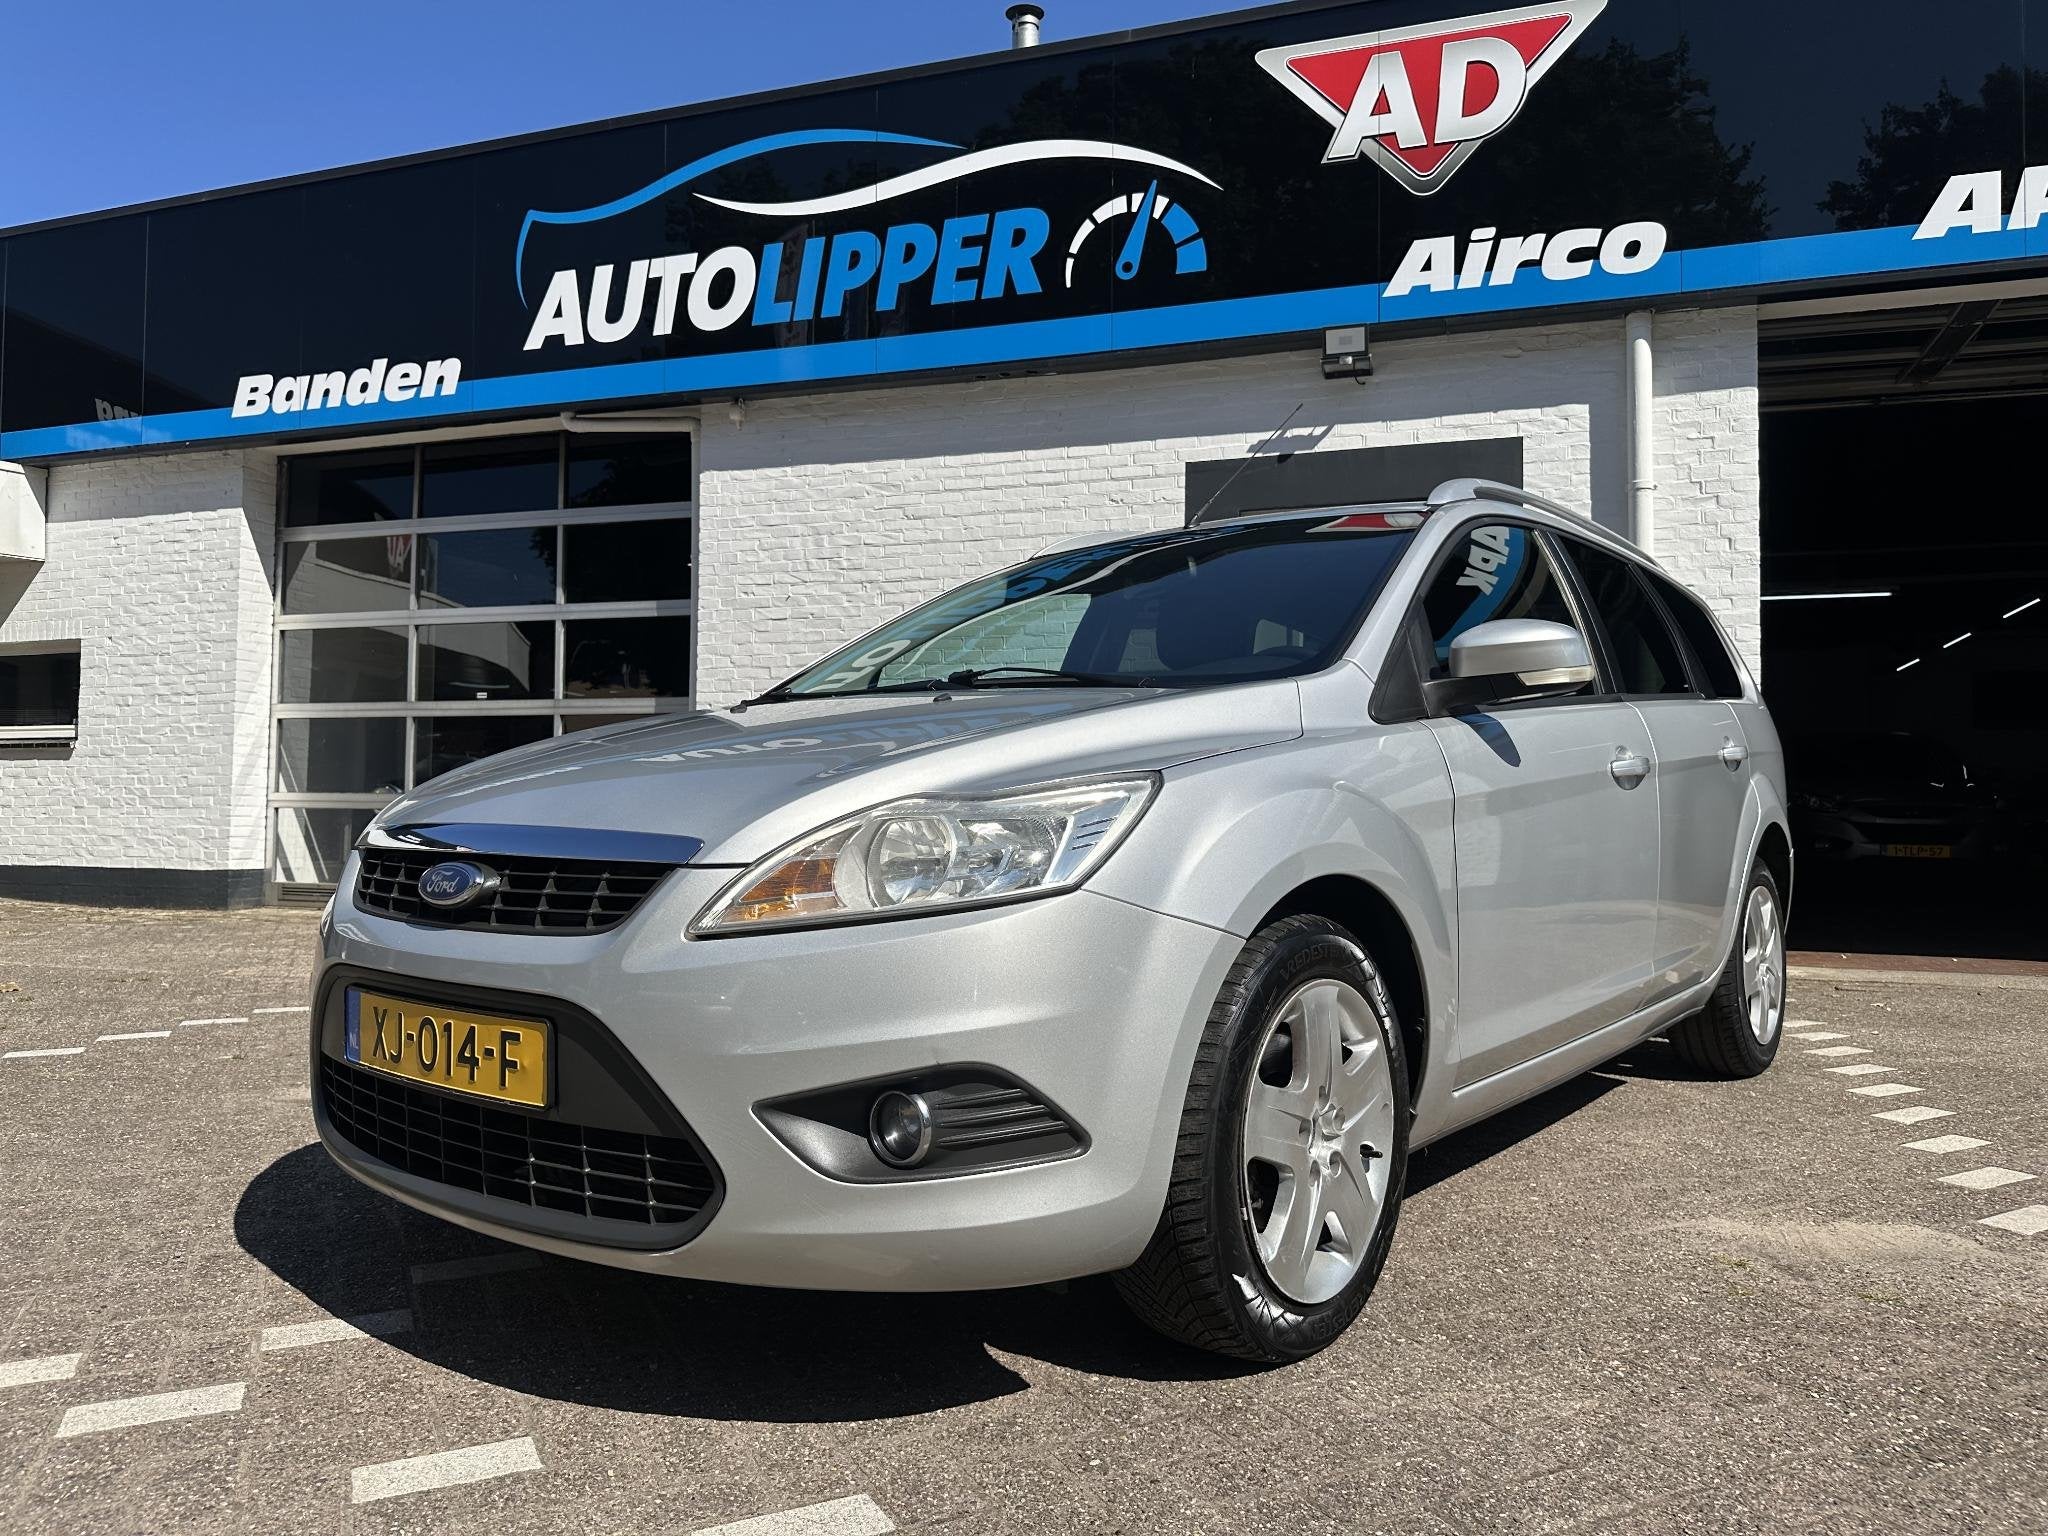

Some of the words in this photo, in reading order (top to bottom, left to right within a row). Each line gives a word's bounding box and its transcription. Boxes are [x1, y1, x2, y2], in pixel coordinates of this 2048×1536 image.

[1321, 36, 1528, 164] AD
[523, 207, 1050, 351] AUTOLIPPER
[1382, 221, 1667, 298] Airco
[231, 357, 463, 419] Banden
[426, 870, 461, 893] Ford
[371, 1006, 523, 1089] XJ-014-F
